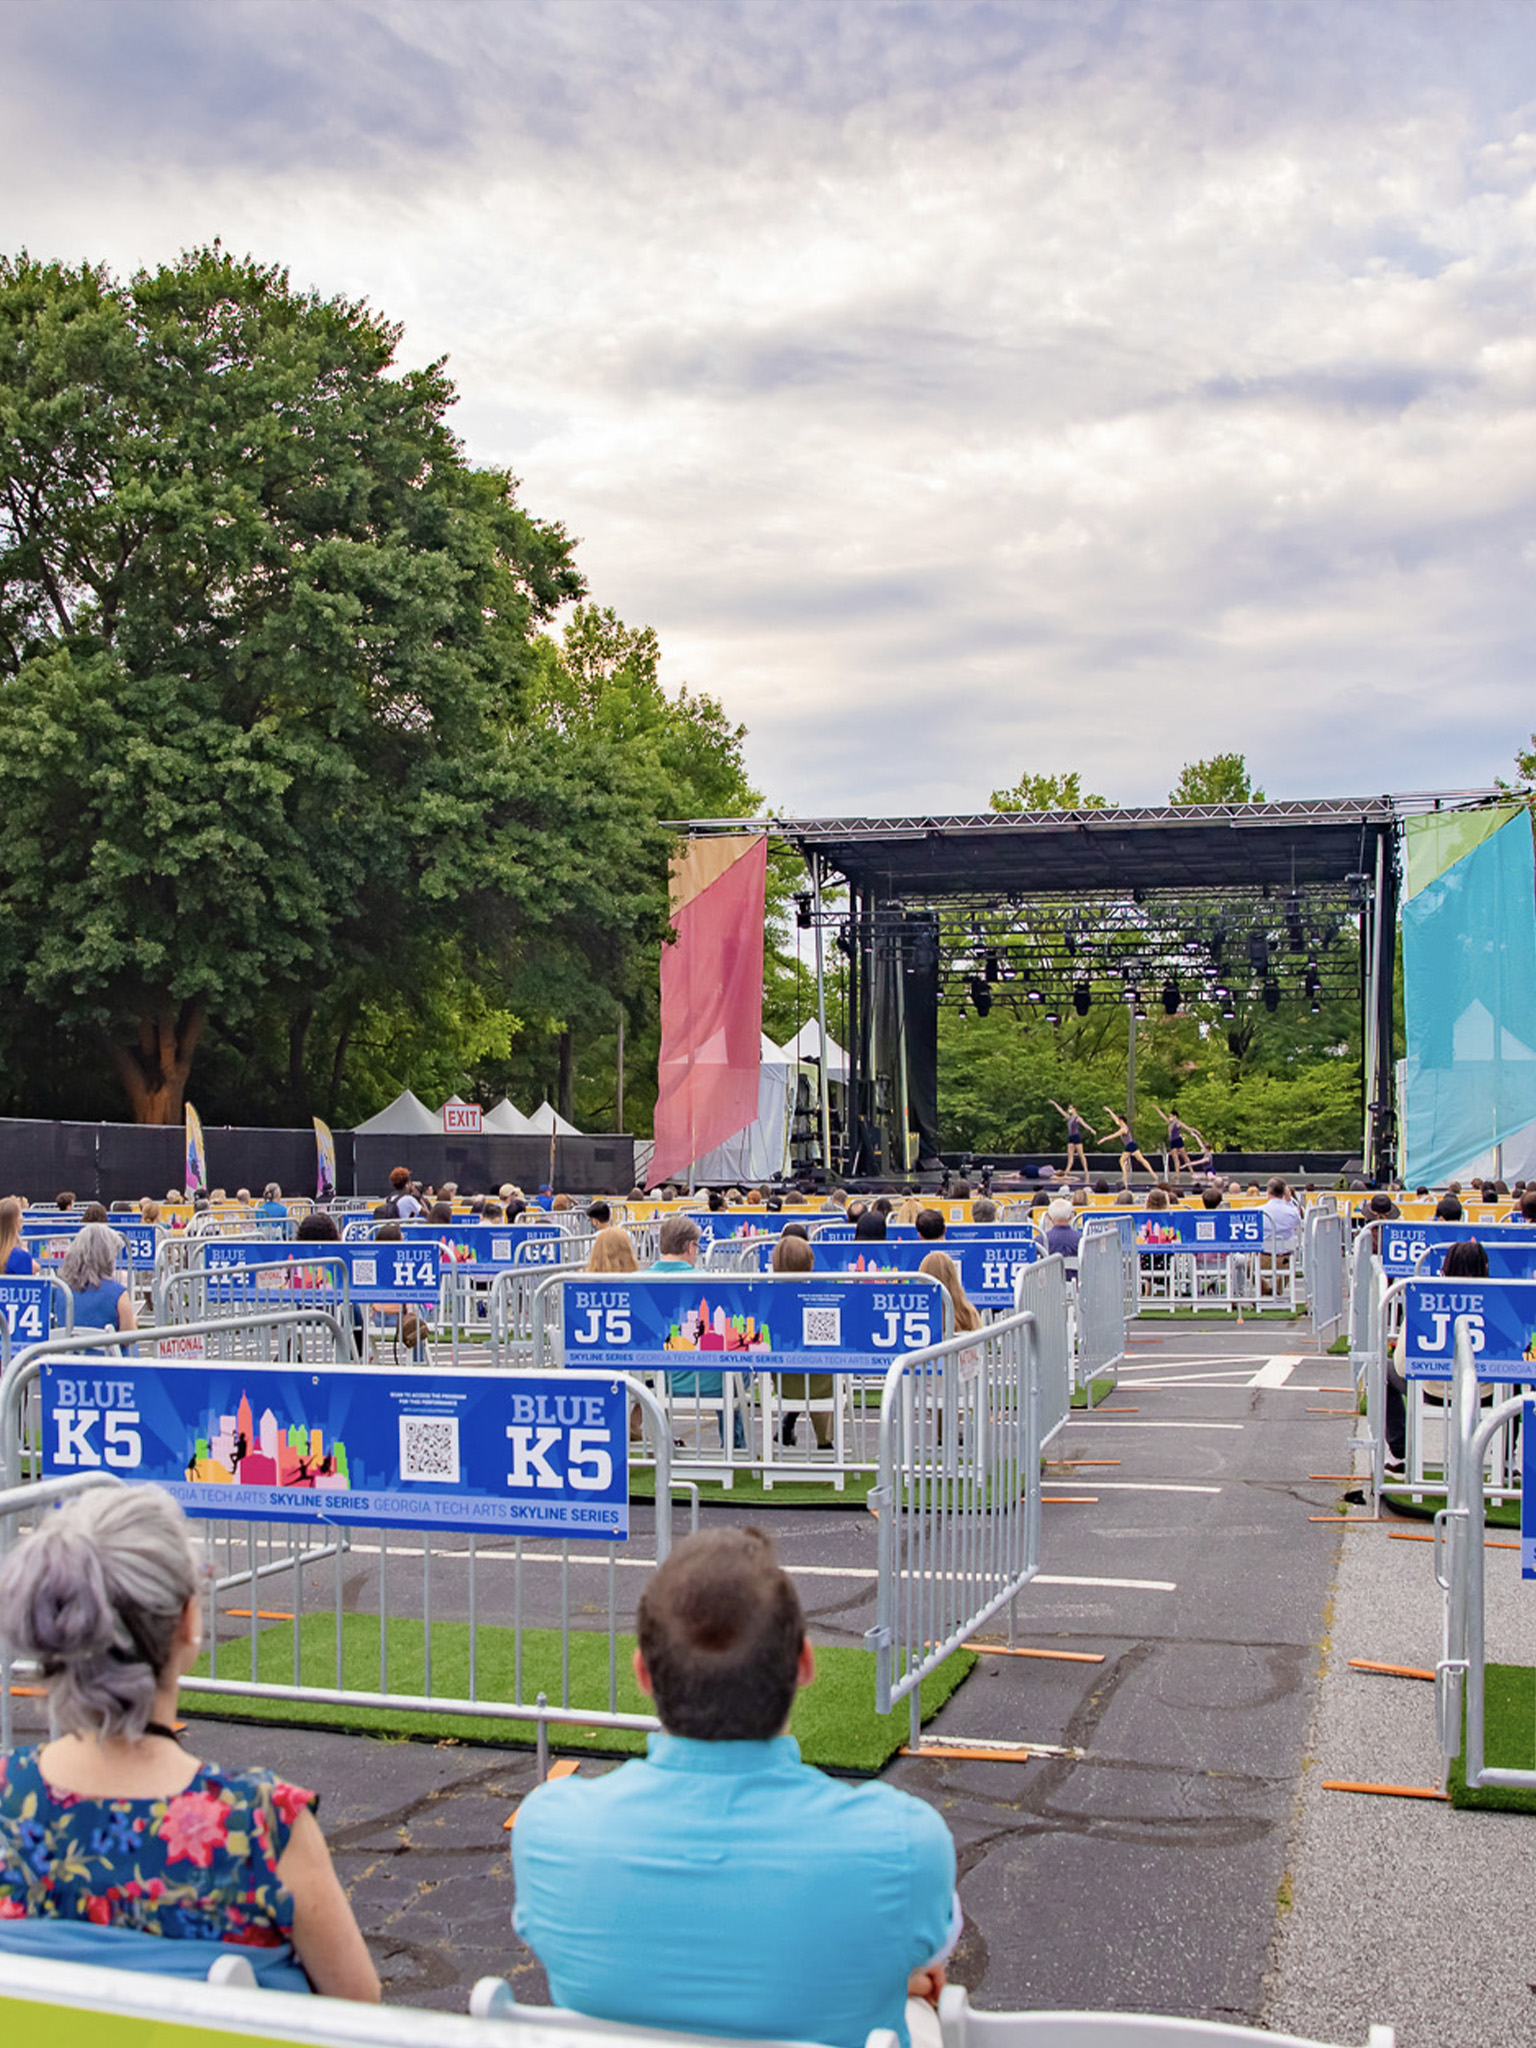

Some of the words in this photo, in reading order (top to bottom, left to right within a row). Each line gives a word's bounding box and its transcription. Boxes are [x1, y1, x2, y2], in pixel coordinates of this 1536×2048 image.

[448, 1111, 477, 1127] EXIT
[1229, 1223, 1258, 1240] F5
[1391, 1230, 1426, 1241] BLUE
[212, 1249, 246, 1261] BLUE
[396, 1250, 432, 1262] BLUE
[985, 1248, 1027, 1262] BLUE
[1389, 1241, 1427, 1263] G6
[393, 1262, 437, 1286] H4
[0, 1287, 42, 1304] BLUE
[575, 1291, 630, 1308] BLUE
[872, 1293, 930, 1311] BLUE
[1420, 1293, 1484, 1313] BLUE
[5, 1304, 43, 1337] J4
[574, 1309, 632, 1344] J5
[871, 1312, 931, 1348] J5
[1417, 1313, 1486, 1353] J6
[160, 1336, 203, 1355] NATIONAL
[569, 1353, 603, 1361] SKYLINE
[605, 1353, 634, 1362] SERIES
[719, 1354, 753, 1363] SKYLINE
[755, 1354, 784, 1363] SERIES
[1411, 1361, 1451, 1371] SKYLINE
[57, 1379, 135, 1408] BLUE
[511, 1394, 605, 1426] BLUE
[53, 1408, 142, 1468] K5
[506, 1426, 613, 1491] K5
[200, 1489, 233, 1503] TECH
[235, 1490, 268, 1505] ARTS
[269, 1492, 322, 1507] SKYLINE
[325, 1495, 370, 1510] SERIES
[373, 1498, 431, 1514] GEORGIA
[433, 1501, 470, 1516] TECH
[472, 1503, 507, 1517] ARTS
[510, 1505, 567, 1521] SKYLINE
[570, 1508, 619, 1524] SERIES
